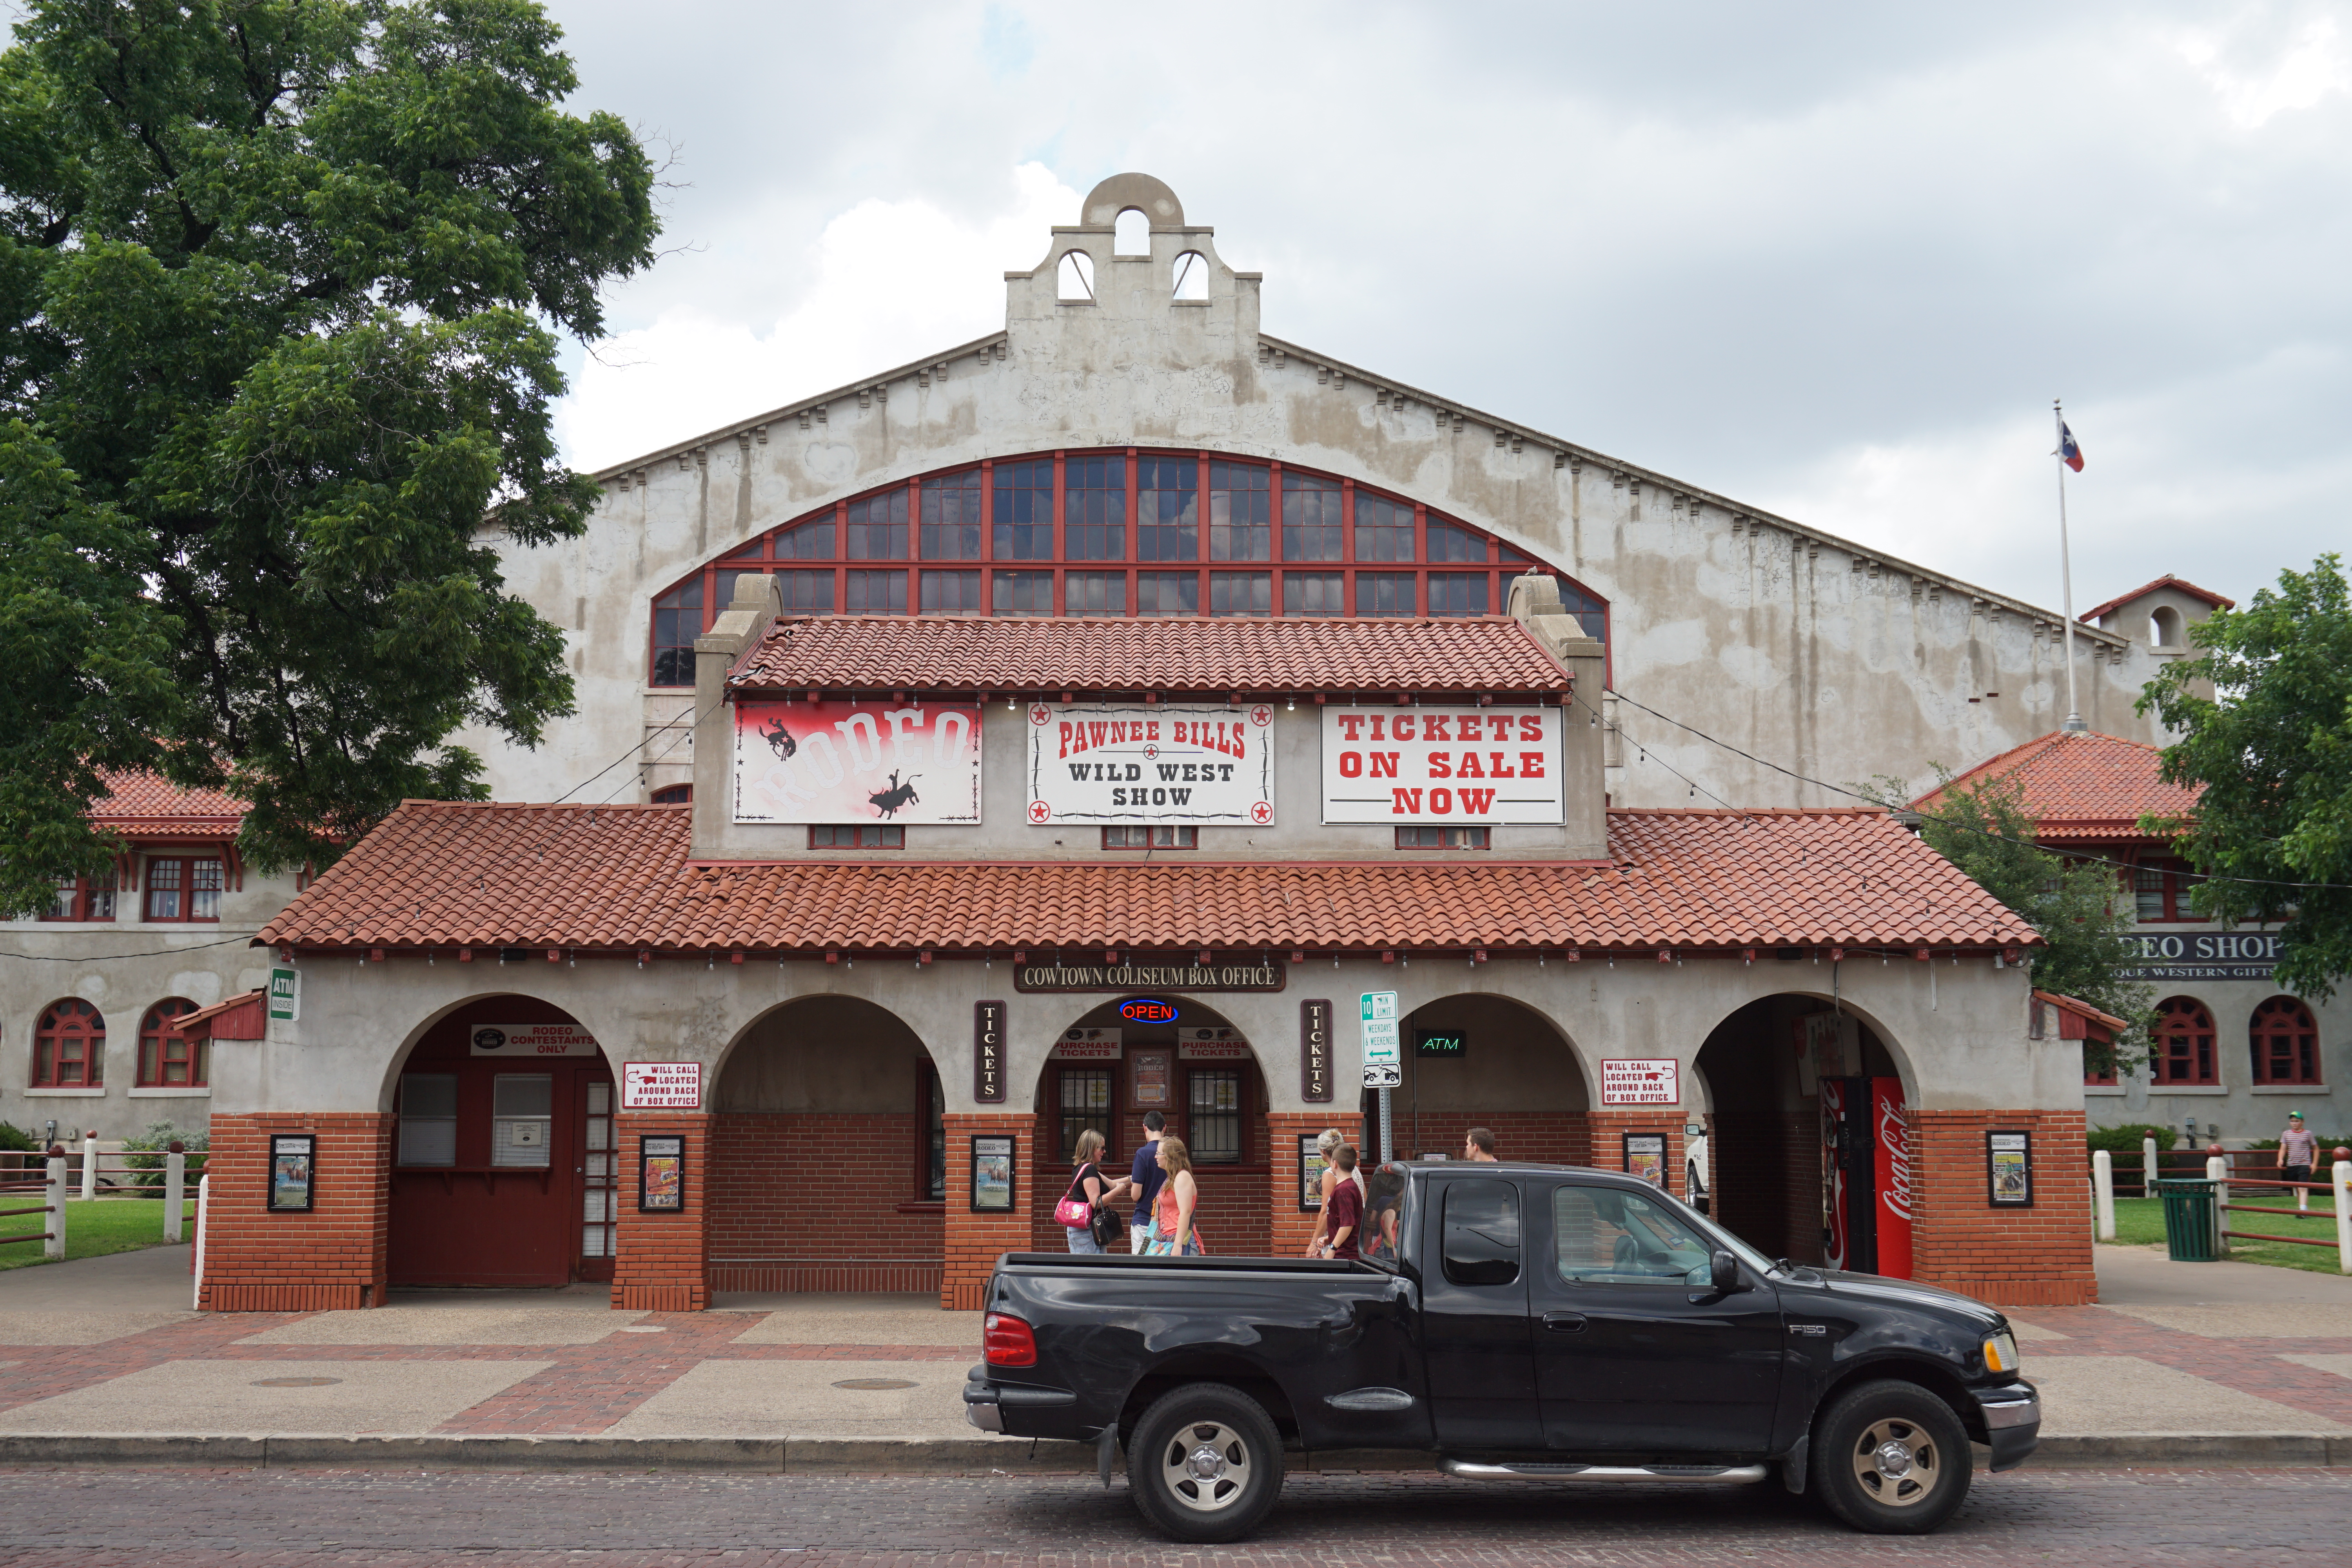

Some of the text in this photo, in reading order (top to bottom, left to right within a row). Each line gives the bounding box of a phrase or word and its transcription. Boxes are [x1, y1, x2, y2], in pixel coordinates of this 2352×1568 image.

[1339, 715, 1543, 741] TICKETS
[1059, 721, 1244, 760] PAWNEE BILLS
[753, 709, 970, 818] RODEO
[1340, 751, 1544, 778] ON SALE
[1069, 764, 1234, 782] WILD WEST
[1113, 788, 1191, 806] SHOW
[1392, 788, 1495, 815] NOW
[2097, 936, 2284, 958] DEO SHOP
[1025, 967, 1275, 985] COWTOWN COLISEUM BOX OFFICE
[2152, 968, 2227, 976] WESTERN
[273, 978, 294, 994] ATM
[273, 1000, 292, 1009] INSIDE
[1123, 1006, 1172, 1019] OPEN
[1363, 996, 1388, 1014] 10 MIN
[1377, 1007, 1391, 1016] LIMIT
[1368, 1024, 1392, 1033] WEEKDAYS
[1365, 1035, 1395, 1046] & WEEKENDS
[1423, 1038, 1459, 1050] ATM
[984, 1007, 995, 1095] TICKETS
[1310, 1006, 1322, 1094] TICKETS
[1789, 1325, 1826, 1334] F-150
